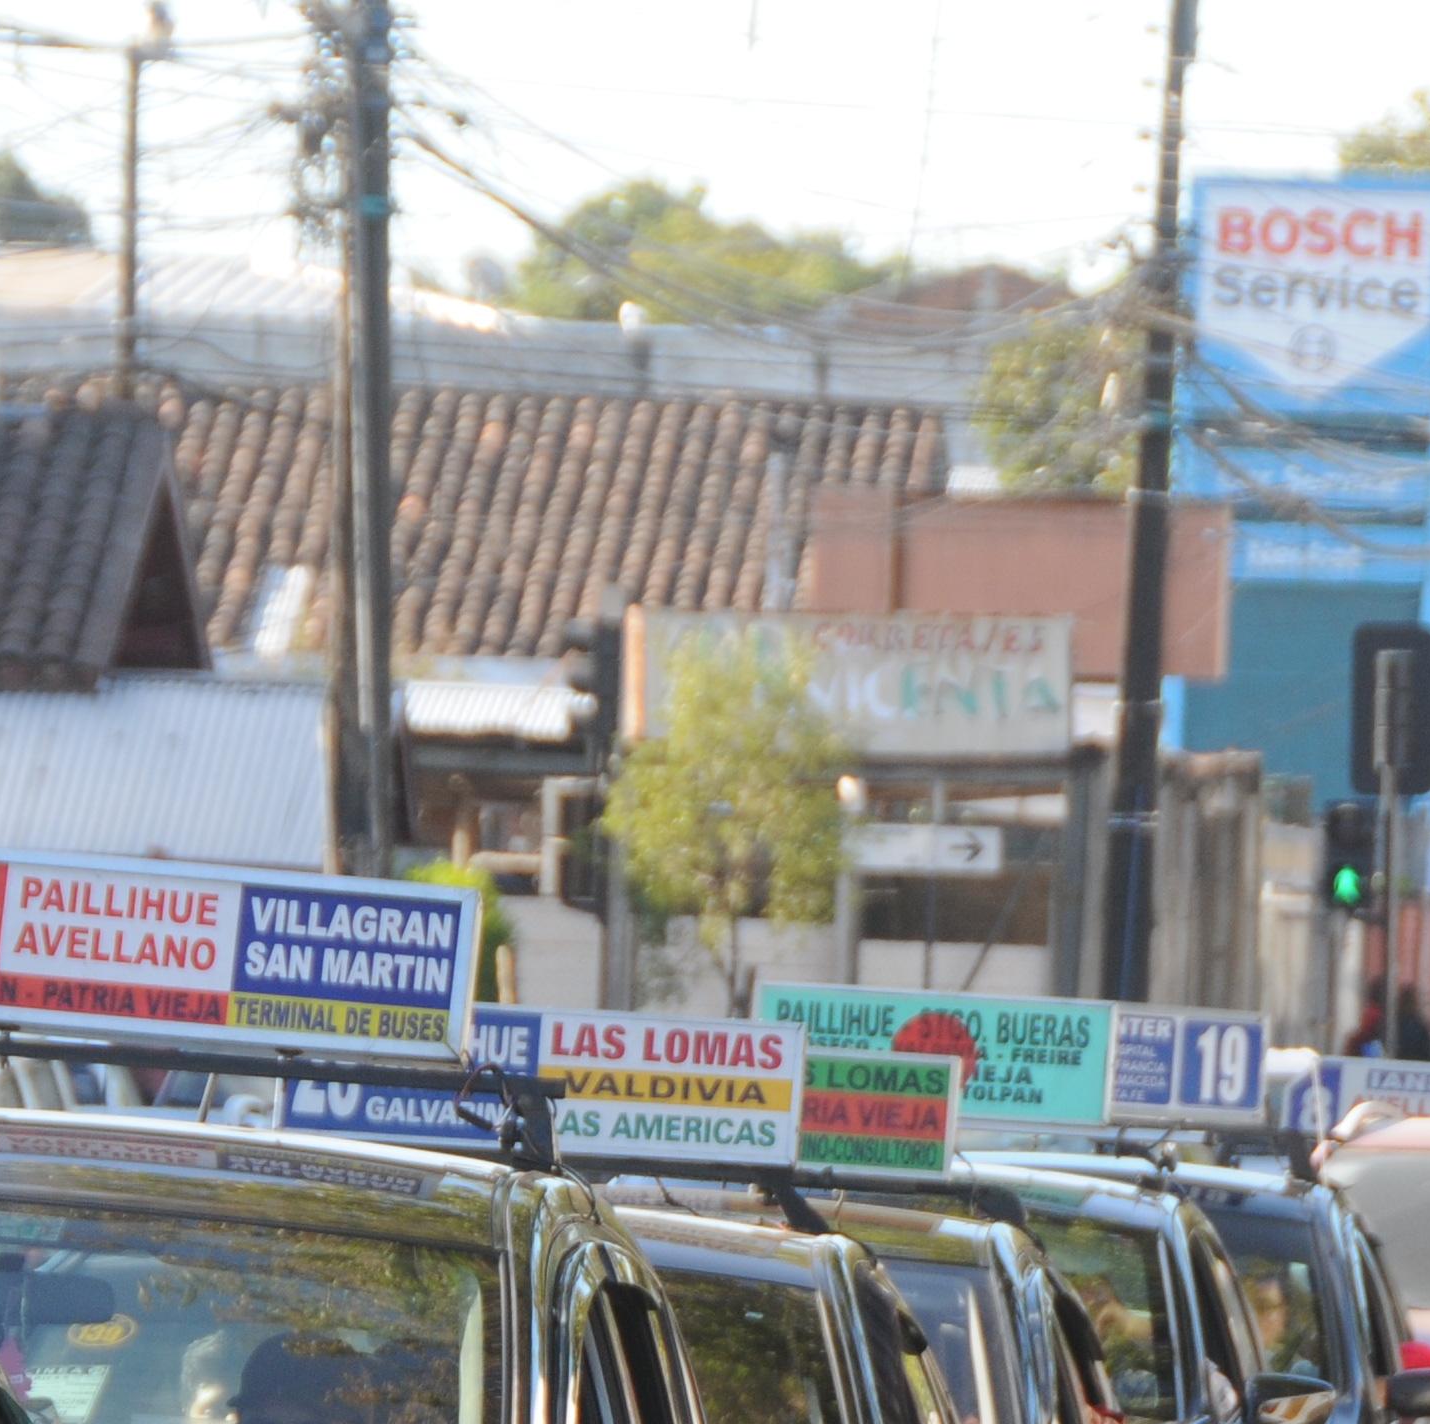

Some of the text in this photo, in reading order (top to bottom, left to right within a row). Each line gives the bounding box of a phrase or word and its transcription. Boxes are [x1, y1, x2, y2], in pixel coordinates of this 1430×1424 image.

[1216, 207, 1424, 258] BOSCH
[1211, 264, 1421, 312] Service
[19, 875, 220, 927] PAILLIHUE
[251, 895, 453, 949] VILLAGRAN
[12, 921, 217, 971] AVELLANO
[244, 941, 450, 994] SAN MARTIN
[42, 979, 136, 1017] PATRIA
[145, 988, 222, 1024] VIEJA
[234, 998, 447, 1043] TERMINAL DE BUSES
[777, 998, 895, 1037] PAILLIHUE
[996, 1011, 1091, 1049] BUERAS
[550, 1021, 783, 1071] LAS LOMAS
[1010, 1047, 1083, 1067] FREIRE
[1196, 1024, 1250, 1103] 19
[565, 1069, 768, 1105] VALDIVIA
[828, 1060, 946, 1096] LOMAS
[973, 1064, 1033, 1085] IEJA
[556, 1108, 777, 1148] AS AMERICAS
[858, 1101, 940, 1132] VIEJA
